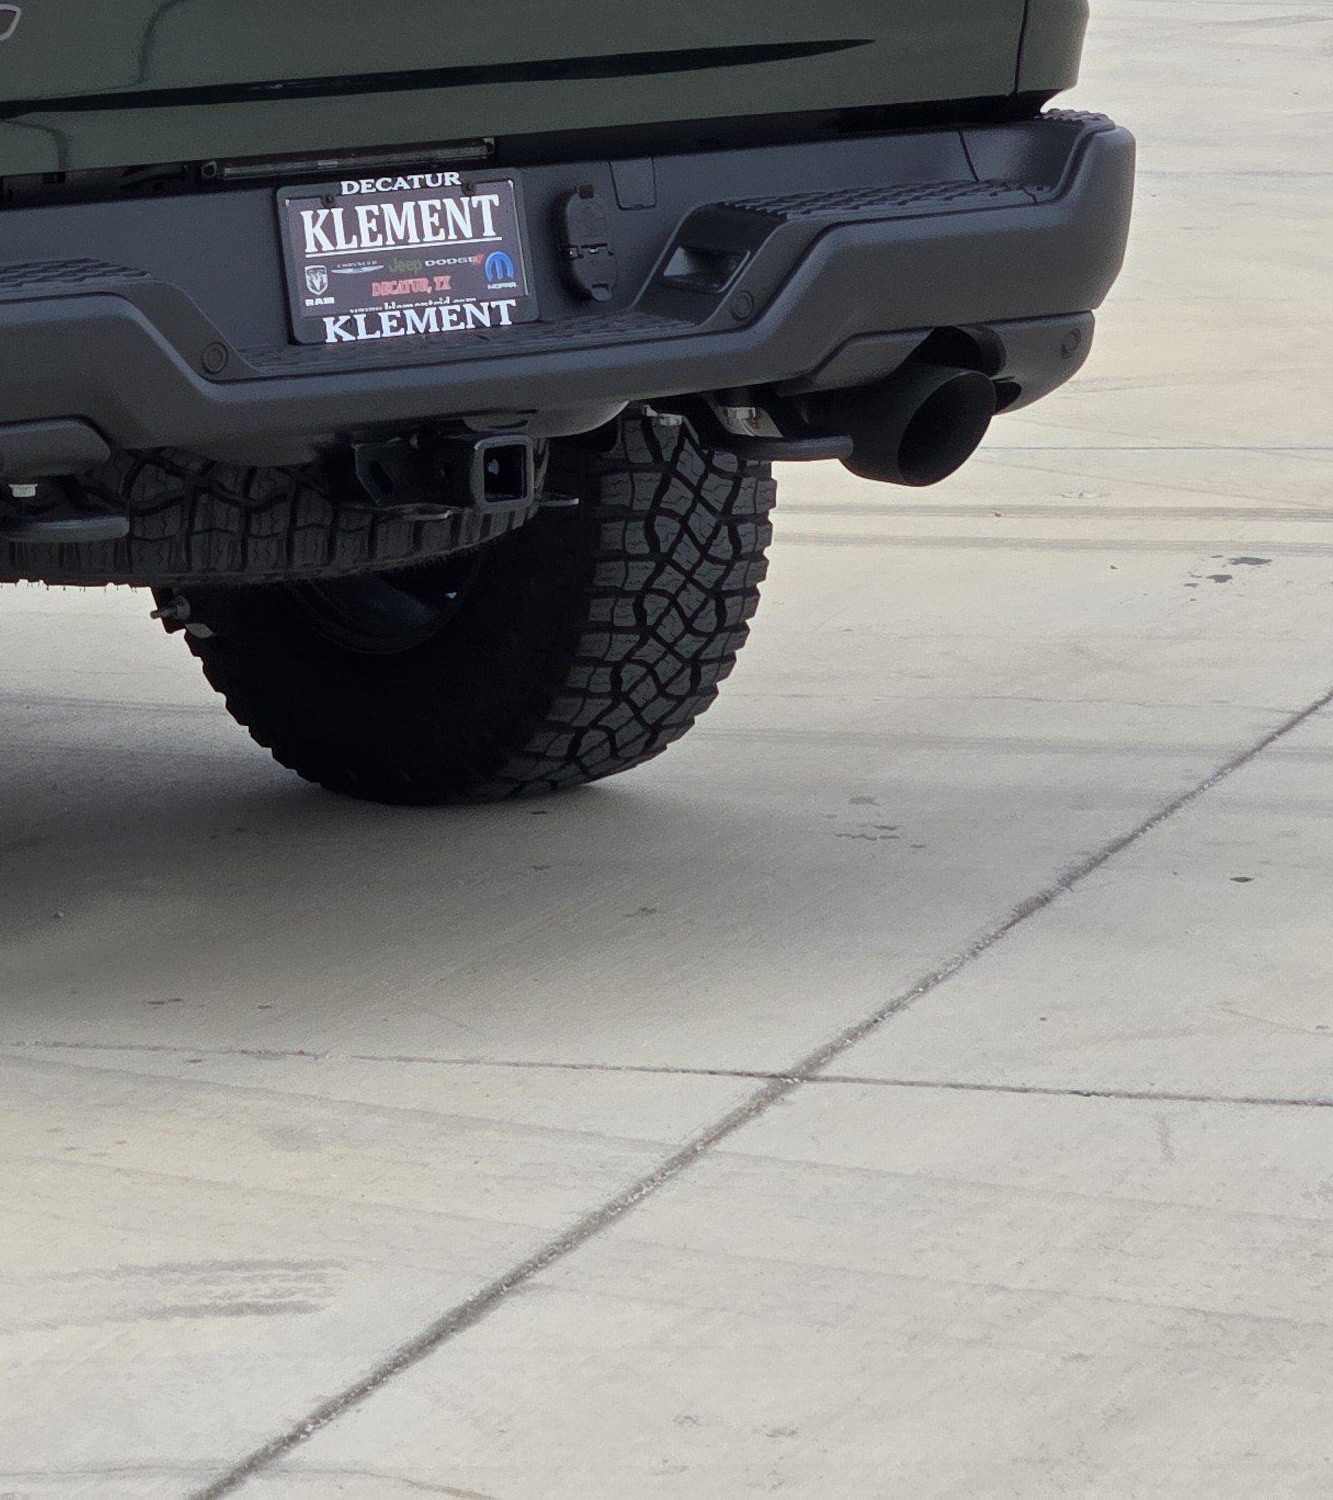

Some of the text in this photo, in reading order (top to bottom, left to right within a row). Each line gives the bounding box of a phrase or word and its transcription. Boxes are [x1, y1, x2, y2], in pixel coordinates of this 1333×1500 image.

[340, 172, 462, 195] DECATUR
[300, 194, 500, 252] KLEMENT
[388, 257, 423, 274] Jeep
[425, 255, 478, 267] DODGE
[434, 275, 452, 291] TX
[305, 297, 335, 307] RAM
[322, 299, 517, 343] KLEMENT
